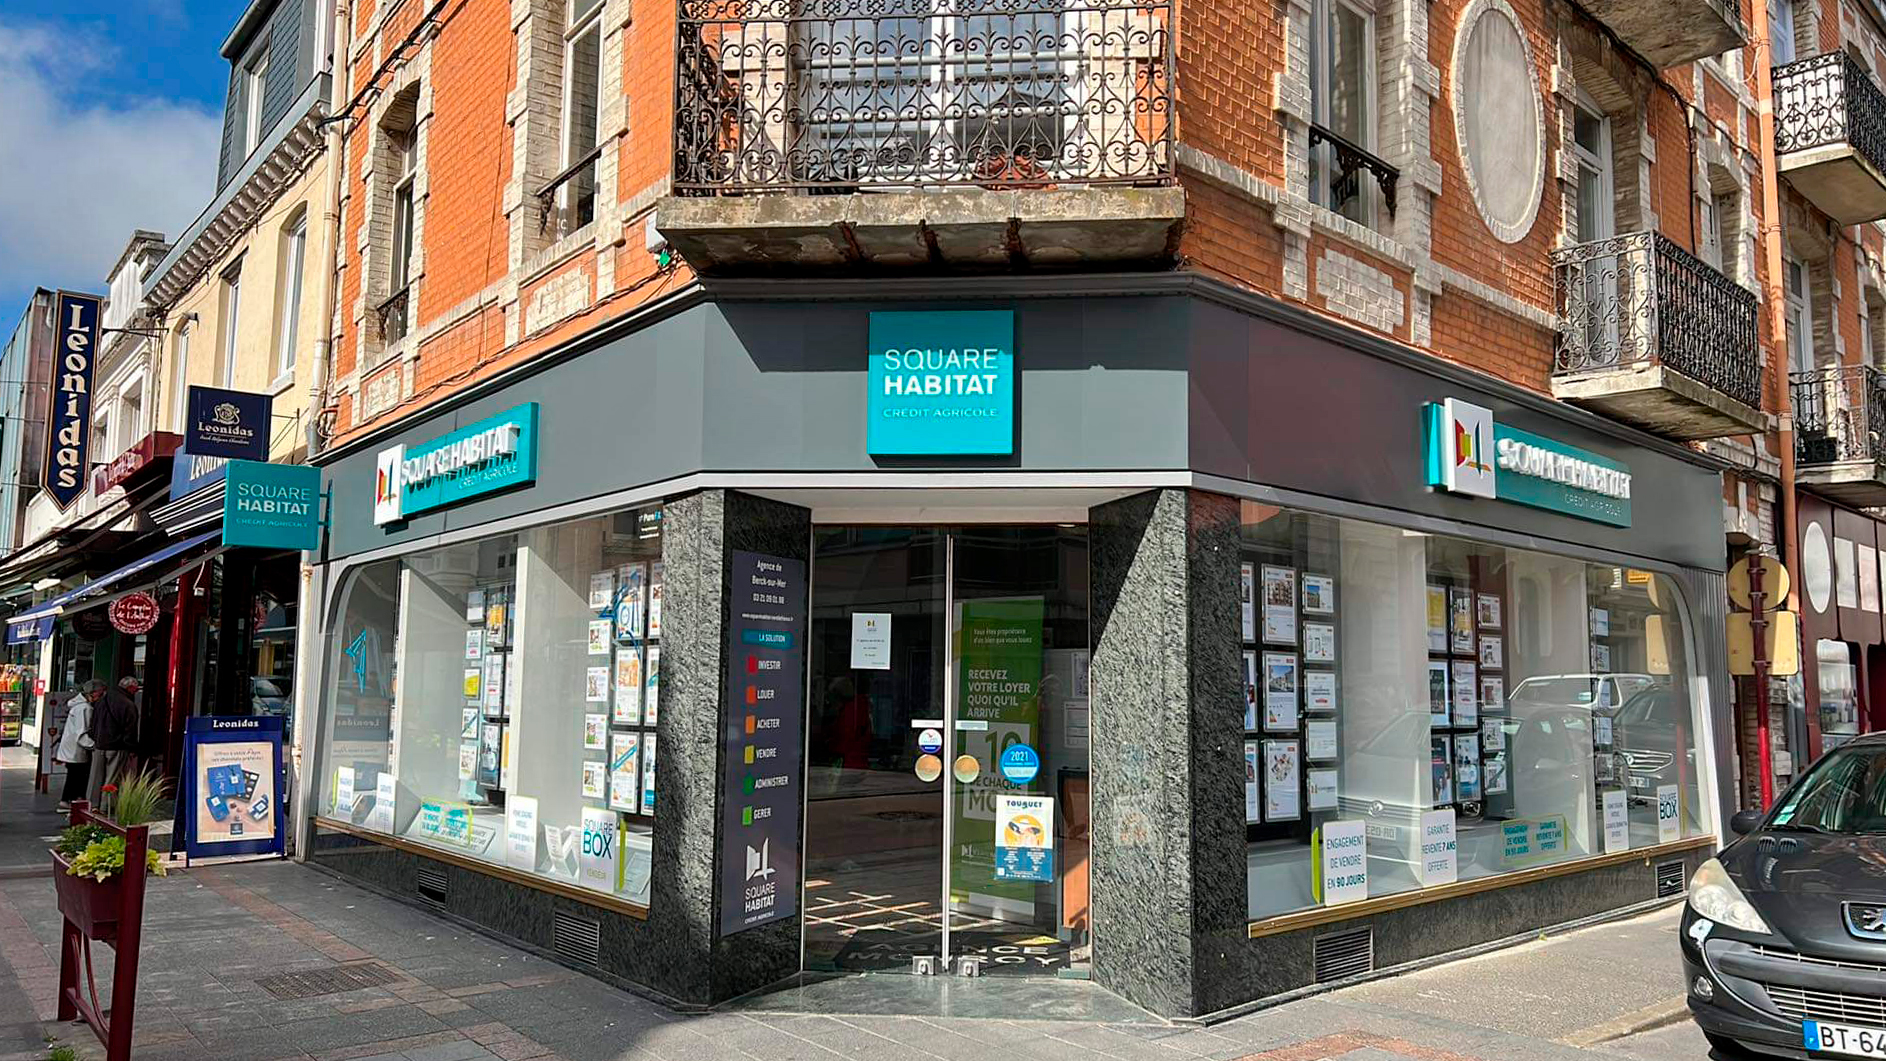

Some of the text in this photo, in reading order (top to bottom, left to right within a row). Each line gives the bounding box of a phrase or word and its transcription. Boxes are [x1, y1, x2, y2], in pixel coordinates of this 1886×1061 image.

[884, 348, 998, 371] SQUARE
[884, 374, 998, 395] HABITAT
[57, 304, 90, 488] Leonidas
[932, 408, 998, 418] AGRICOLE
[197, 421, 254, 437] Leonidas
[401, 422, 520, 486] SQUARE HABITAT
[238, 482, 311, 500] SQUARE
[237, 498, 311, 516] HABITAT
[758, 660, 781, 670] INVESTIR
[968, 669, 1008, 680] RECEVEZ
[757, 689, 775, 700] LOUER
[968, 681, 1031, 694] VOTRE LOYER
[967, 694, 1019, 707] QUOI QU'IL
[967, 707, 1001, 719] ARRIVE
[212, 719, 259, 728] Leonidas
[756, 718, 780, 729] ACHETER
[756, 747, 777, 758] VENDRE
[1010, 751, 1029, 762] 2021
[754, 775, 789, 789] ADMINISTRER
[982, 777, 1022, 791] CHAQUE
[1659, 799, 1678, 820] BOX
[584, 819, 613, 834] SQUARE
[583, 830, 613, 860] BOX
[1326, 834, 1364, 849] ENGAGEMENT
[1330, 854, 1362, 869] DE VENDRE
[1327, 873, 1366, 889] EN 90 JOURS
[745, 881, 776, 901] SQUARE
[744, 894, 776, 913] HABITAT
